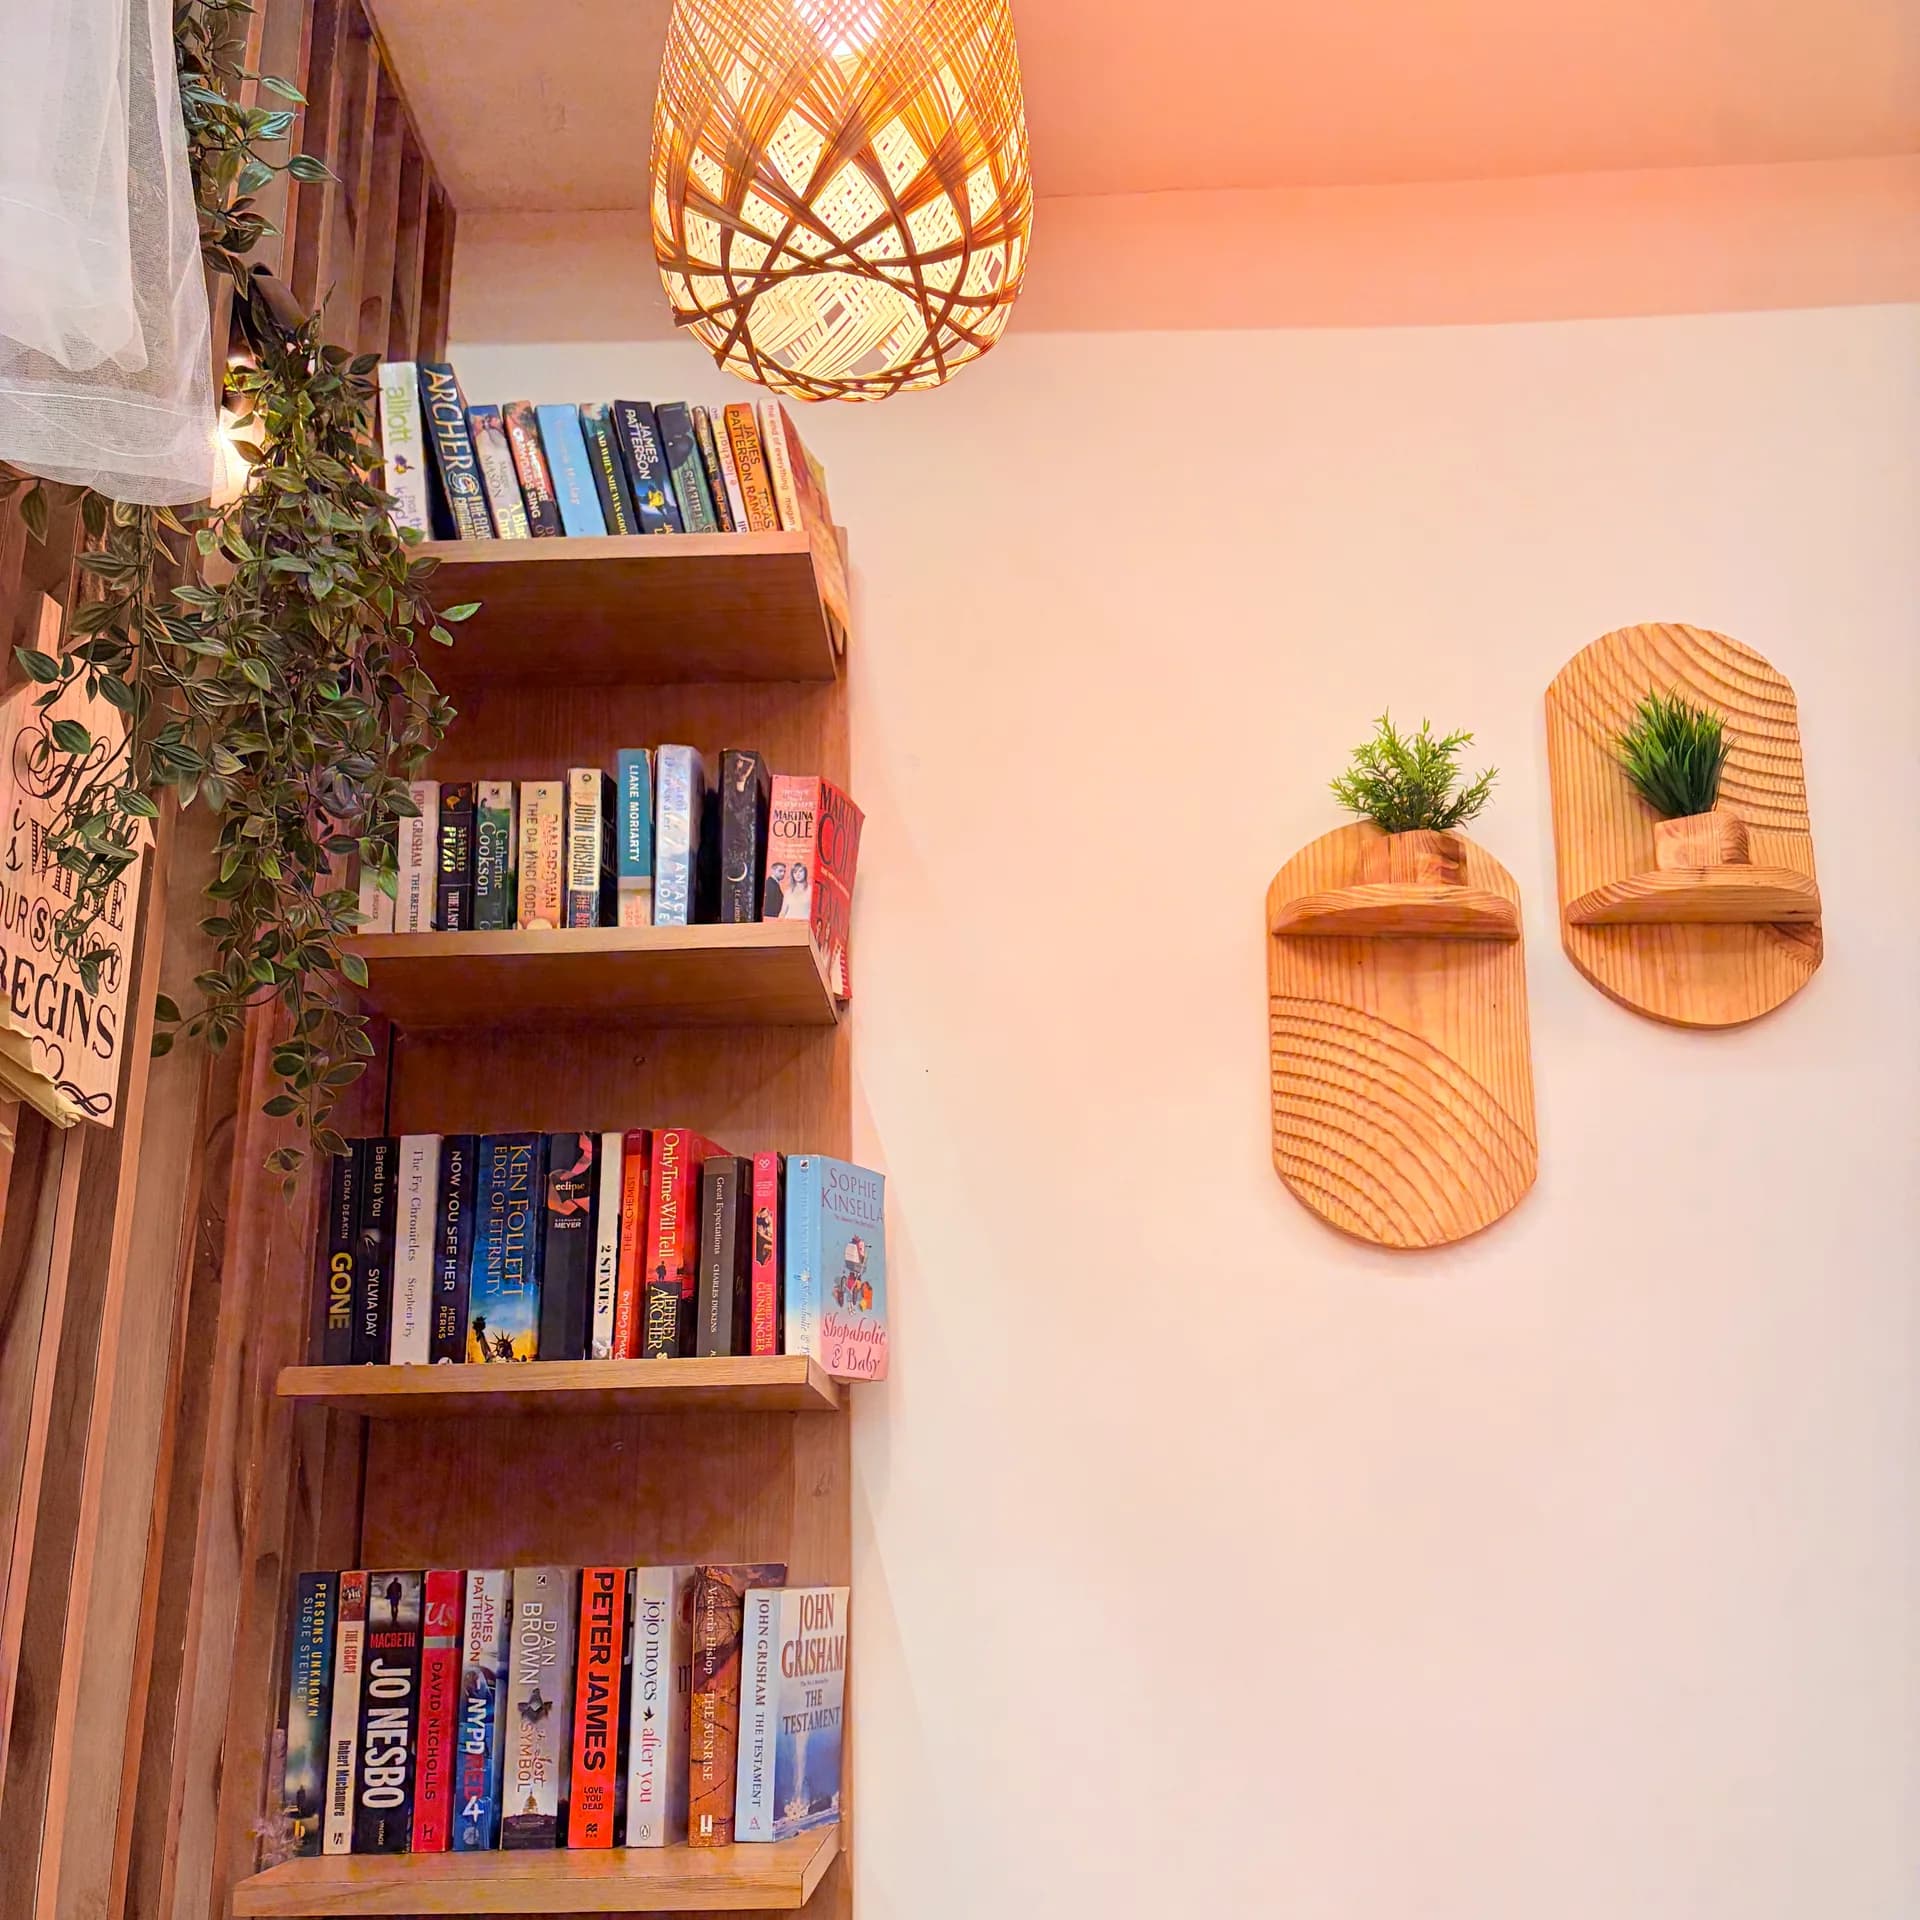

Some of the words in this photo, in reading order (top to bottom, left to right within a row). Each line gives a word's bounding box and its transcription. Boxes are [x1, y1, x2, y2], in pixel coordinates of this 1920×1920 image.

[424, 368, 474, 470] ARCHER
[770, 420, 779, 436] end
[625, 408, 652, 480] PATTERSON
[639, 422, 659, 464] JAMES
[729, 410, 752, 482] PATTERSON
[742, 424, 760, 465] JAMES
[773, 437, 782, 446] of
[484, 455, 504, 498] MASON
[512, 427, 535, 490] CRAWDADS
[526, 489, 541, 518] SING
[600, 447, 613, 475] WHEN
[774, 447, 789, 490] everything
[536, 477, 549, 502] THE
[606, 474, 618, 496] SHE
[610, 495, 623, 512] WAS
[684, 469, 704, 519] THIEVES
[757, 488, 775, 529] TEXAS
[784, 498, 796, 526] megan
[628, 764, 639, 798] LIANE
[526, 802, 539, 825] THE
[574, 802, 596, 833] JOHN
[628, 801, 640, 862] MORIARTY
[772, 820, 813, 839] COLE
[774, 809, 814, 821] MARTINA
[410, 818, 425, 867] GRISHAM
[442, 826, 457, 873] PUZO
[456, 826, 467, 872] MARIO
[526, 828, 538, 843] DA
[477, 821, 497, 897] Cookson
[494, 829, 508, 889] Catherine
[525, 849, 538, 881] VINCI
[573, 835, 595, 887] GRISHAM
[673, 862, 687, 885] AN
[411, 873, 421, 891] THE
[448, 890, 460, 908] THE
[658, 879, 672, 921] LOVE
[447, 908, 459, 927] LAST
[524, 885, 537, 918] CODE
[576, 894, 591, 910] THE
[673, 890, 686, 922] ACT
[374, 1146, 387, 1181] Bared
[413, 1148, 425, 1171] The
[450, 1150, 463, 1187] NOW
[491, 1146, 508, 1188] EDGE
[509, 1144, 532, 1192] KEN
[659, 1133, 680, 1171] Only
[343, 1168, 353, 1200] LEONA
[373, 1183, 384, 1195] to
[408, 1174, 424, 1195] Fry
[491, 1191, 505, 1213] OF
[555, 1181, 586, 1195] eclipse
[660, 1167, 679, 1202] Time
[715, 1176, 725, 1200] Great
[830, 1167, 877, 1201] SOPHIE
[340, 1202, 350, 1240] DEAKIN
[372, 1196, 385, 1217] You
[448, 1190, 461, 1222] YOU
[624, 1176, 636, 1231] ALCHEMIST
[659, 1202, 678, 1232] Will
[821, 1187, 884, 1223] KINSELLA
[407, 1197, 423, 1262] Chronicles
[446, 1226, 459, 1255] SEE
[623, 1234, 633, 1252] THE
[658, 1232, 676, 1258] Tell
[712, 1202, 724, 1255] Expectations
[485, 1218, 503, 1298] ETERNITY
[502, 1199, 530, 1297] FOLLETT
[600, 1244, 611, 1254] 2
[329, 1252, 353, 1331] GONE
[366, 1268, 381, 1311] SYLVIA
[444, 1258, 457, 1292] HER
[598, 1257, 612, 1316] STATES
[711, 1264, 720, 1298] CHARLES
[404, 1277, 418, 1316] Stephen
[365, 1313, 379, 1337] DAY
[402, 1319, 415, 1338] Fry
[438, 1305, 448, 1340] PERKS
[446, 1307, 457, 1336] HEIDI
[648, 1286, 665, 1351] ARCHER
[662, 1291, 680, 1342] JEFFREY
[710, 1299, 720, 1334] DICKENS
[754, 1281, 766, 1352] GUNSLINGER
[823, 1312, 886, 1345] Shopaholic
[763, 1334, 772, 1349] THE
[832, 1343, 843, 1369] &
[847, 1346, 881, 1378] Baby
[300, 1597, 314, 1638] SUSIE
[312, 1583, 327, 1645] PERSONS
[470, 1576, 484, 1662] PATTERSON
[481, 1595, 495, 1643] JAMES
[589, 1572, 615, 1664] PETER
[643, 1598, 665, 1639] jojo
[704, 1586, 718, 1634] Victoria
[756, 1598, 770, 1639] JOHN
[797, 1593, 836, 1639] JOHN
[344, 1629, 359, 1642] THE
[370, 1631, 416, 1649] MACBETH
[519, 1602, 543, 1685] BROWN
[541, 1620, 558, 1667] DAN
[296, 1643, 311, 1703] STEINER
[343, 1644, 358, 1675] ESCAPE
[643, 1642, 665, 1702] moyes
[703, 1636, 717, 1675] Hislop
[755, 1642, 769, 1706] GRISHAM
[781, 1635, 845, 1679] GRISHAM
[307, 1650, 322, 1718] UNKNOWN
[368, 1658, 412, 1699] JO
[430, 1661, 443, 1712] DAVID
[704, 1691, 716, 1718] THE
[805, 1688, 824, 1708] THE
[464, 1698, 487, 1756] NYPD
[583, 1672, 609, 1772] JAMES
[754, 1711, 765, 1735] THE
[782, 1707, 841, 1736] TESTAMENT
[336, 1739, 351, 1768] Robert
[362, 1707, 410, 1809] NESBO
[424, 1719, 440, 1801] NICHOLLS
[517, 1722, 534, 1793] SYMBOL
[640, 1728, 657, 1767] after
[702, 1720, 716, 1782] SUNRISE
[463, 1754, 485, 1801] RED
[533, 1755, 553, 1789] Lost
[583, 1786, 604, 1794] LOVE
[639, 1771, 654, 1803] you
[751, 1736, 765, 1807] TESTAMENT
[333, 1768, 351, 1818] Muchamore
[462, 1796, 484, 1822] 4
[582, 1802, 604, 1810] DEAD
[585, 1794, 602, 1802] YOU
